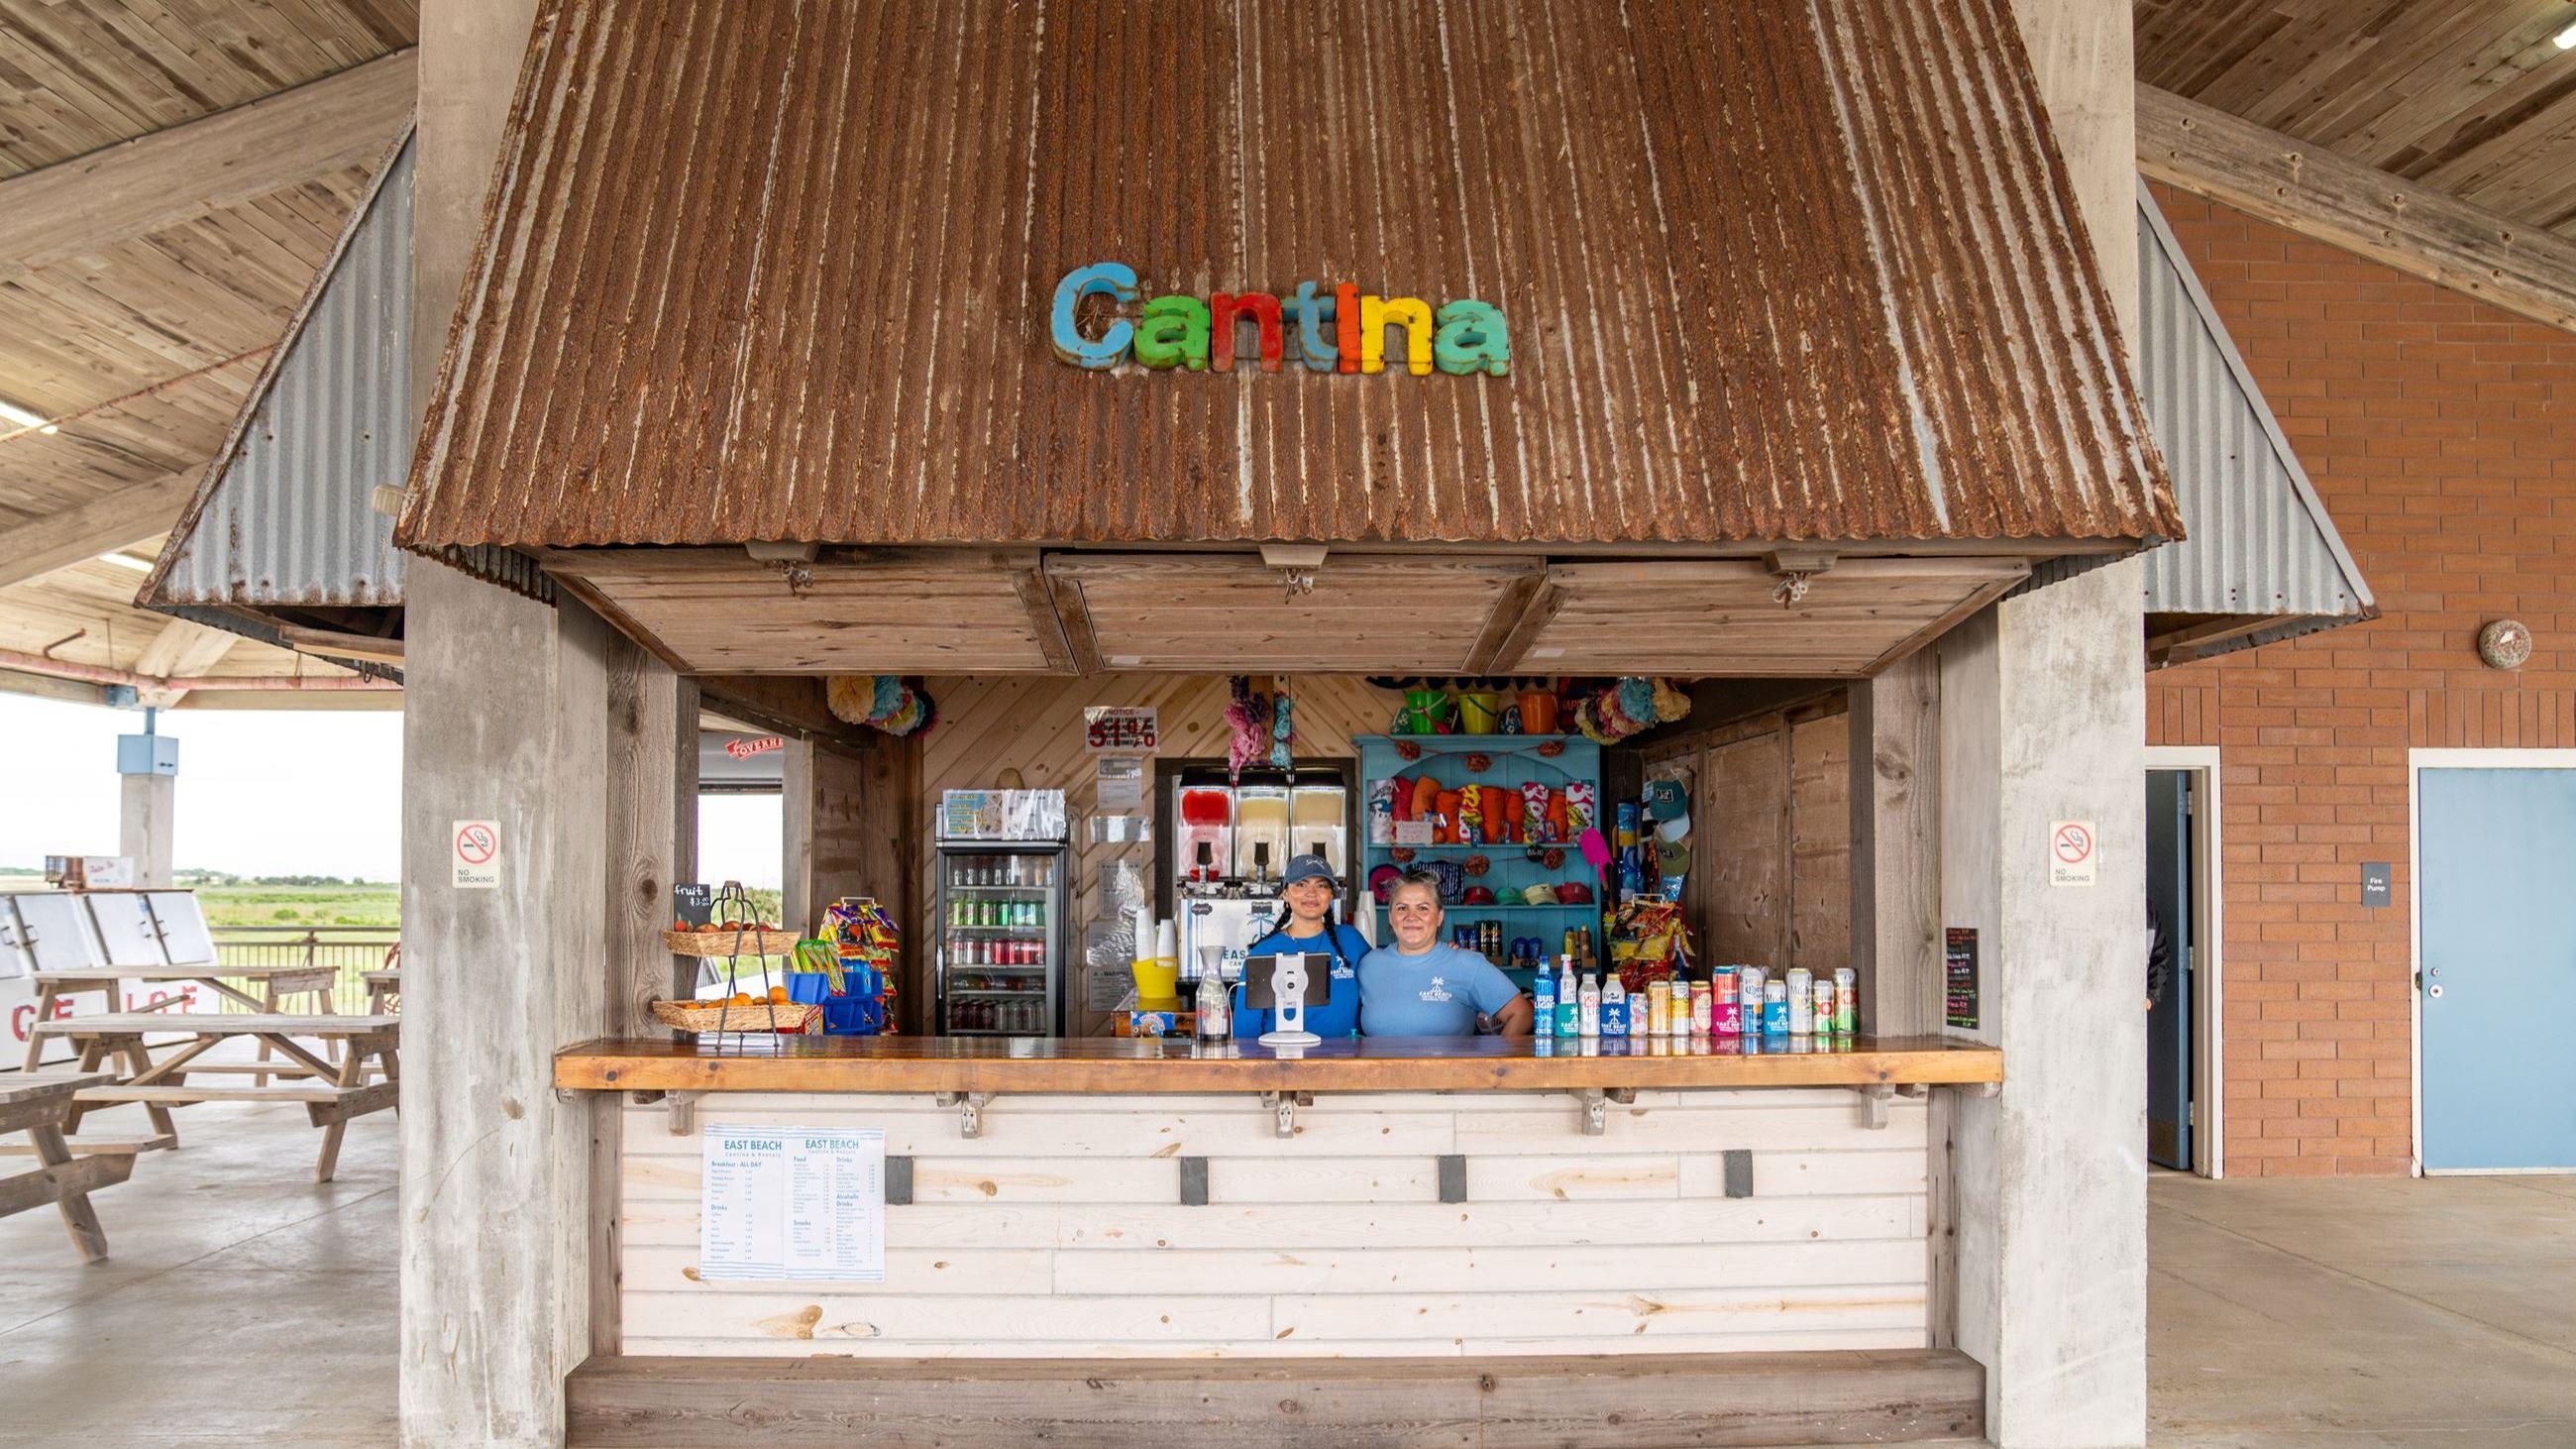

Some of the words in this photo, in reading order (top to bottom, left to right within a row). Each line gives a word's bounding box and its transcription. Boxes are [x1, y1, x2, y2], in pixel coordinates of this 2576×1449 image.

[1051, 262, 1510, 377] Cantina
[674, 884, 703, 896] fruit
[724, 1140, 748, 1150] EAST
[750, 1140, 782, 1151] BEACH
[805, 1140, 828, 1150] EAST
[829, 1140, 859, 1150] BEACH
